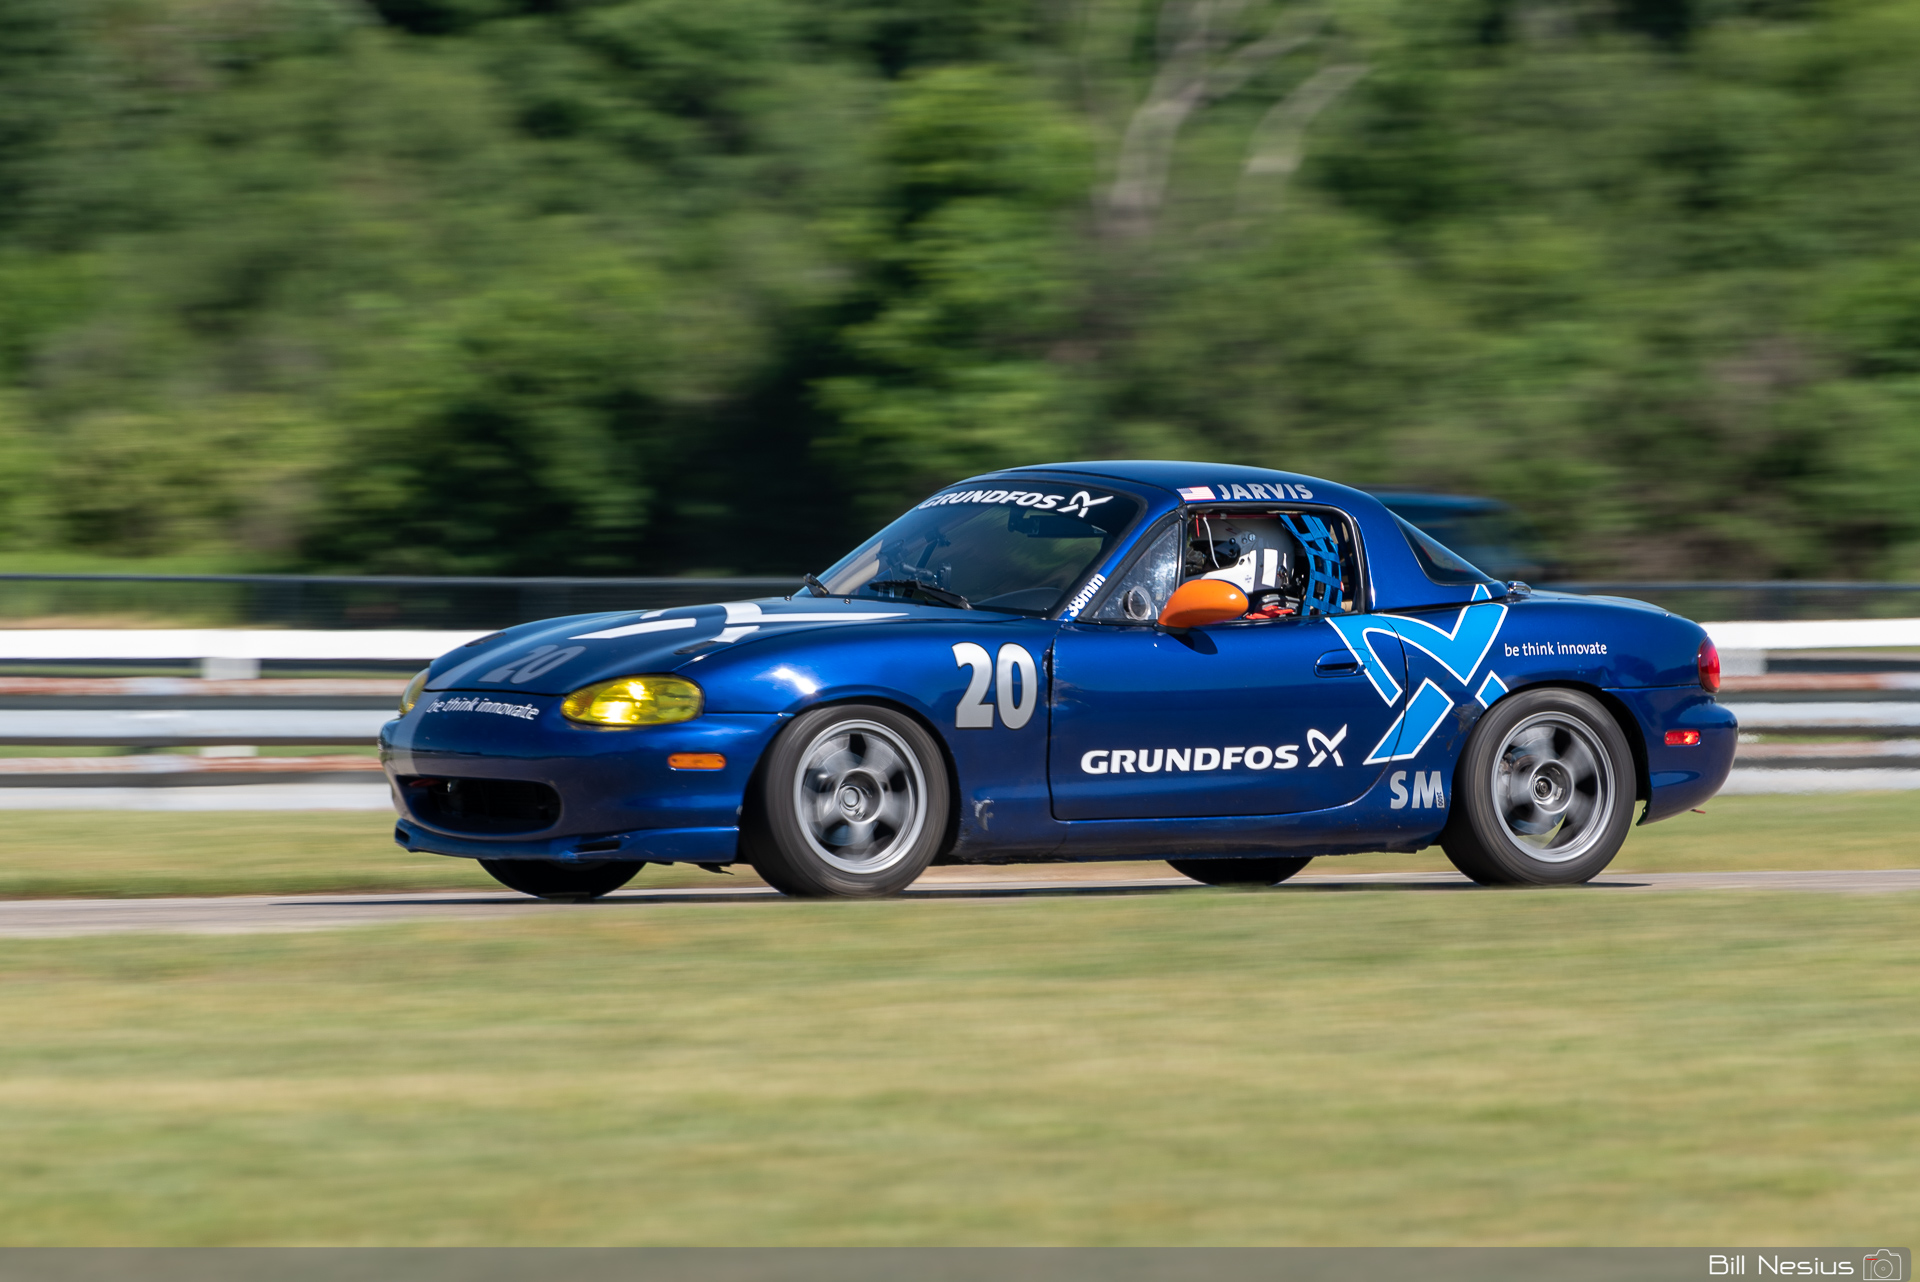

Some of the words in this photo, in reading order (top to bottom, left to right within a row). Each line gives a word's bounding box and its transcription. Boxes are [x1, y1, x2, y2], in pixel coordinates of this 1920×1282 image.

[918, 489, 1065, 509] GRUNDFOS
[1217, 483, 1314, 500] JARVIS
[1064, 573, 1106, 618] 38mm
[478, 644, 587, 684] 20
[1504, 642, 1519, 657] be
[1522, 641, 1555, 657] think
[1557, 641, 1608, 655] innovate
[951, 641, 1038, 731] 20
[426, 698, 445, 713] be
[442, 697, 480, 712] think
[475, 698, 540, 720] innovate
[1081, 744, 1300, 775] GRUNDFOS
[1389, 770, 1445, 810] SM
